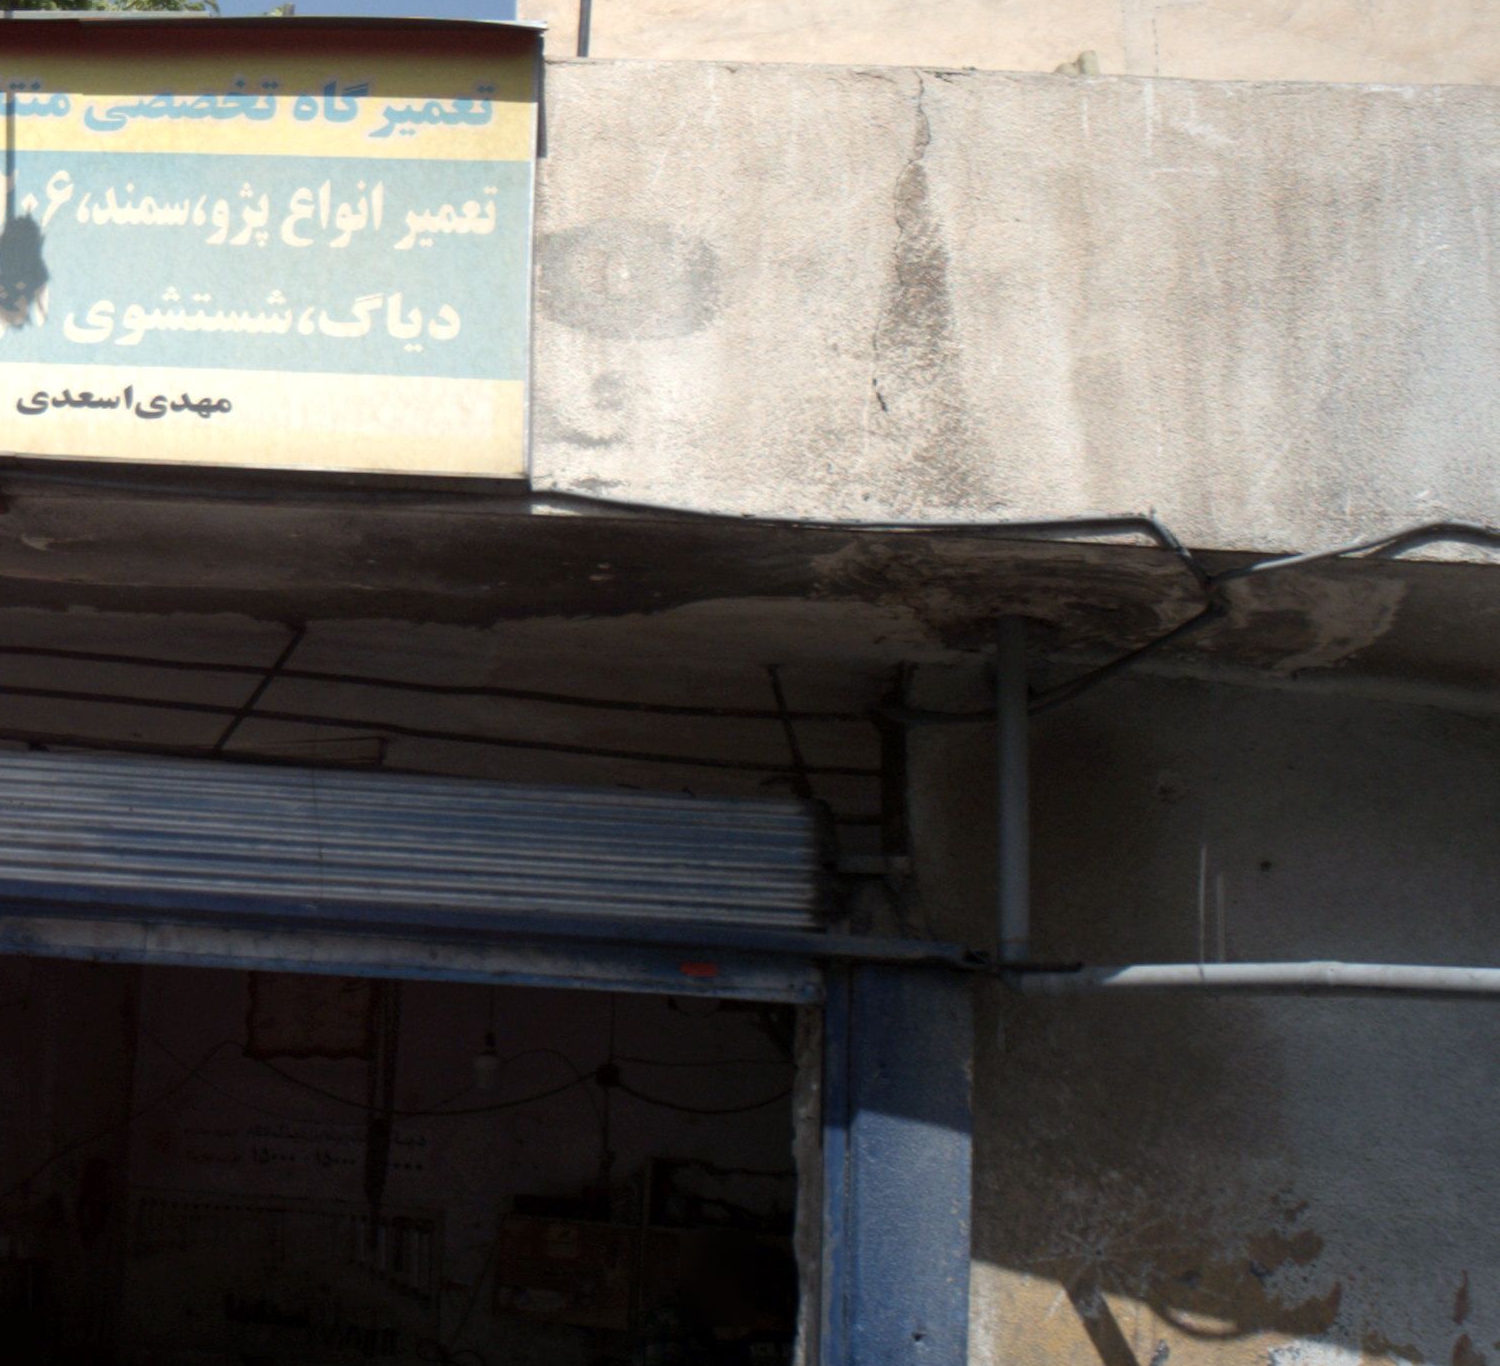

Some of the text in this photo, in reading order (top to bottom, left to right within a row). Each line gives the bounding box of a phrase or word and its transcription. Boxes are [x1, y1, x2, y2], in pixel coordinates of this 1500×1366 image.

[83, 79, 278, 132] تخصصی
[282, 179, 384, 248] انواع
[393, 186, 498, 250] تعمیر
